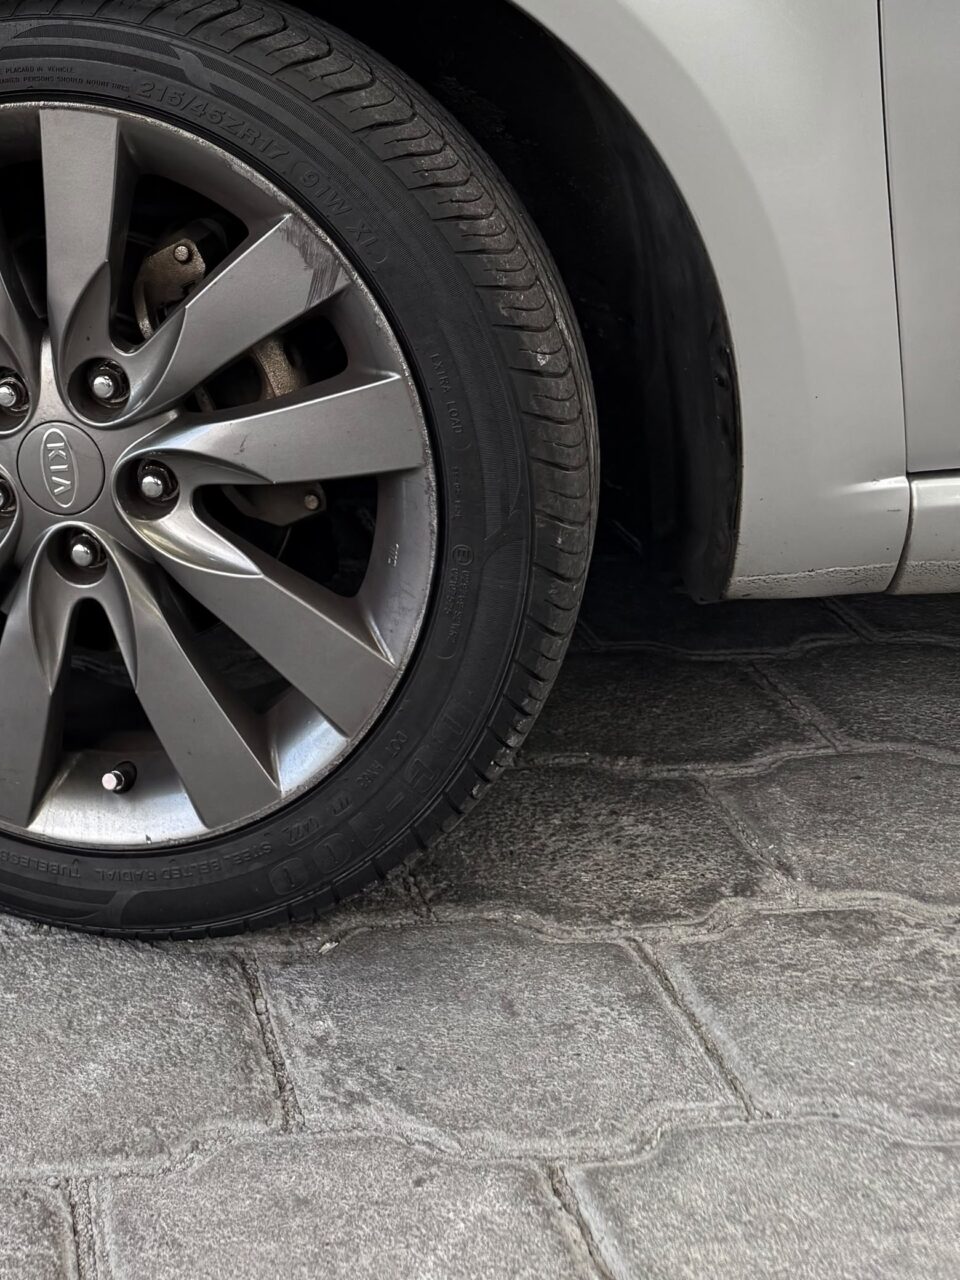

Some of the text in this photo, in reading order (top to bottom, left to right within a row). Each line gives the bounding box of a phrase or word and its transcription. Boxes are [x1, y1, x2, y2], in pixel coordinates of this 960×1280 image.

[136, 81, 290, 161] 215/45ZR17
[445, 400, 464, 434] LOAD
[46, 442, 72, 496] KIA
[94, 841, 273, 883] STEEL BELTED RADIAL
